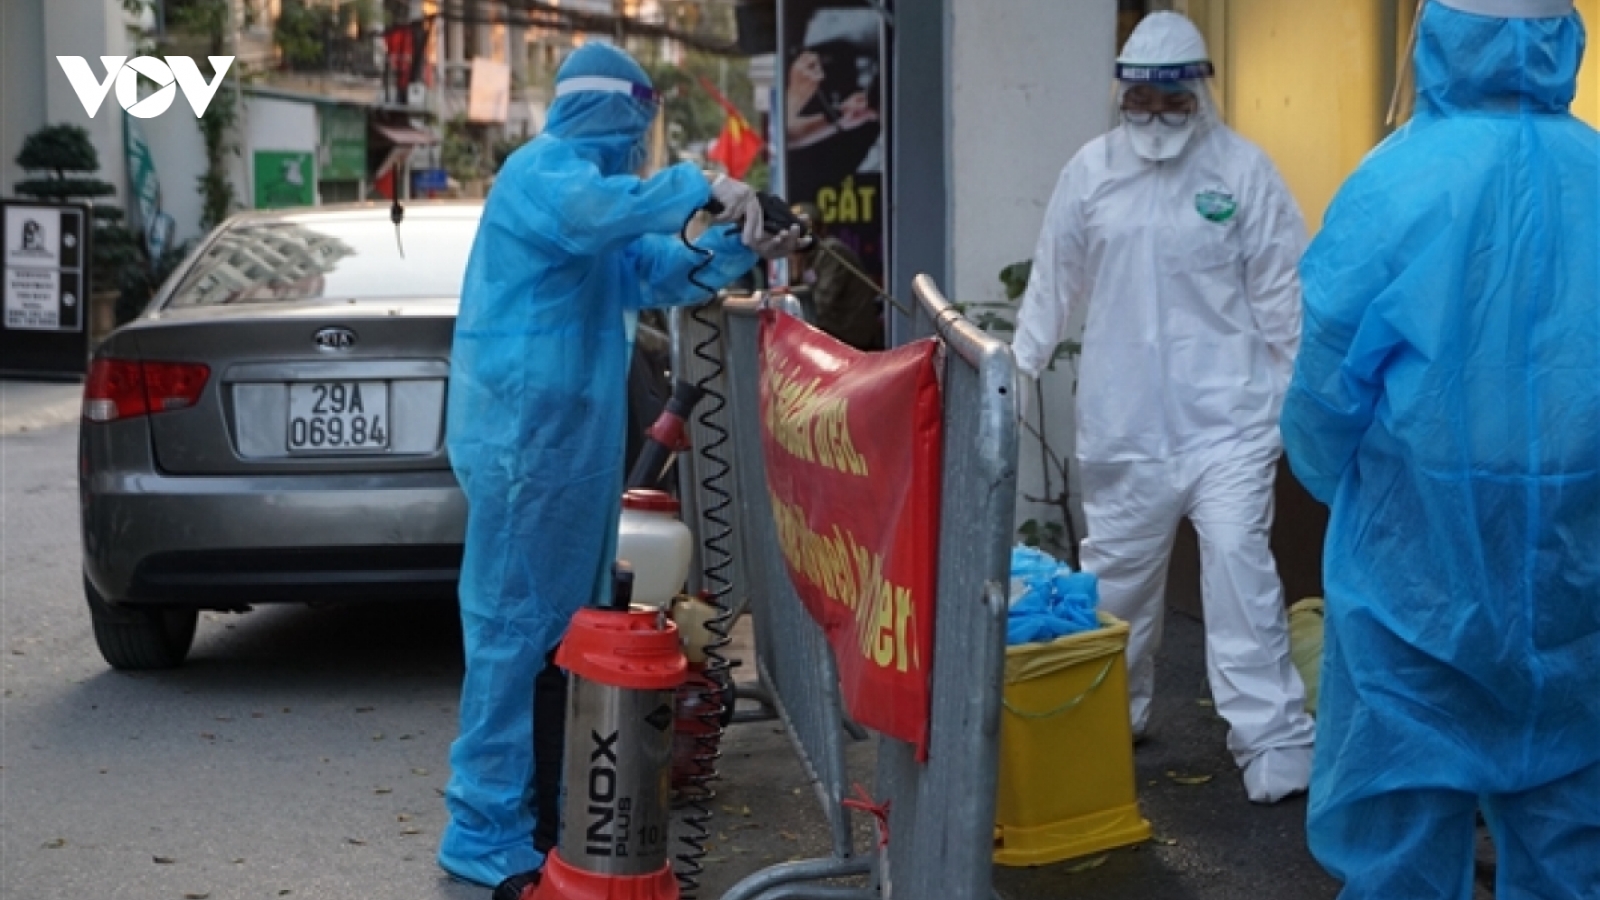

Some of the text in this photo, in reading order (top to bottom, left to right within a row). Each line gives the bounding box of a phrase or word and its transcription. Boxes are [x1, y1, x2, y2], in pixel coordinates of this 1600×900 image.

[312, 383, 364, 414] 29A
[291, 415, 385, 447] 069.84
[586, 729, 619, 857] INOX
[616, 797, 632, 857] PLUS
